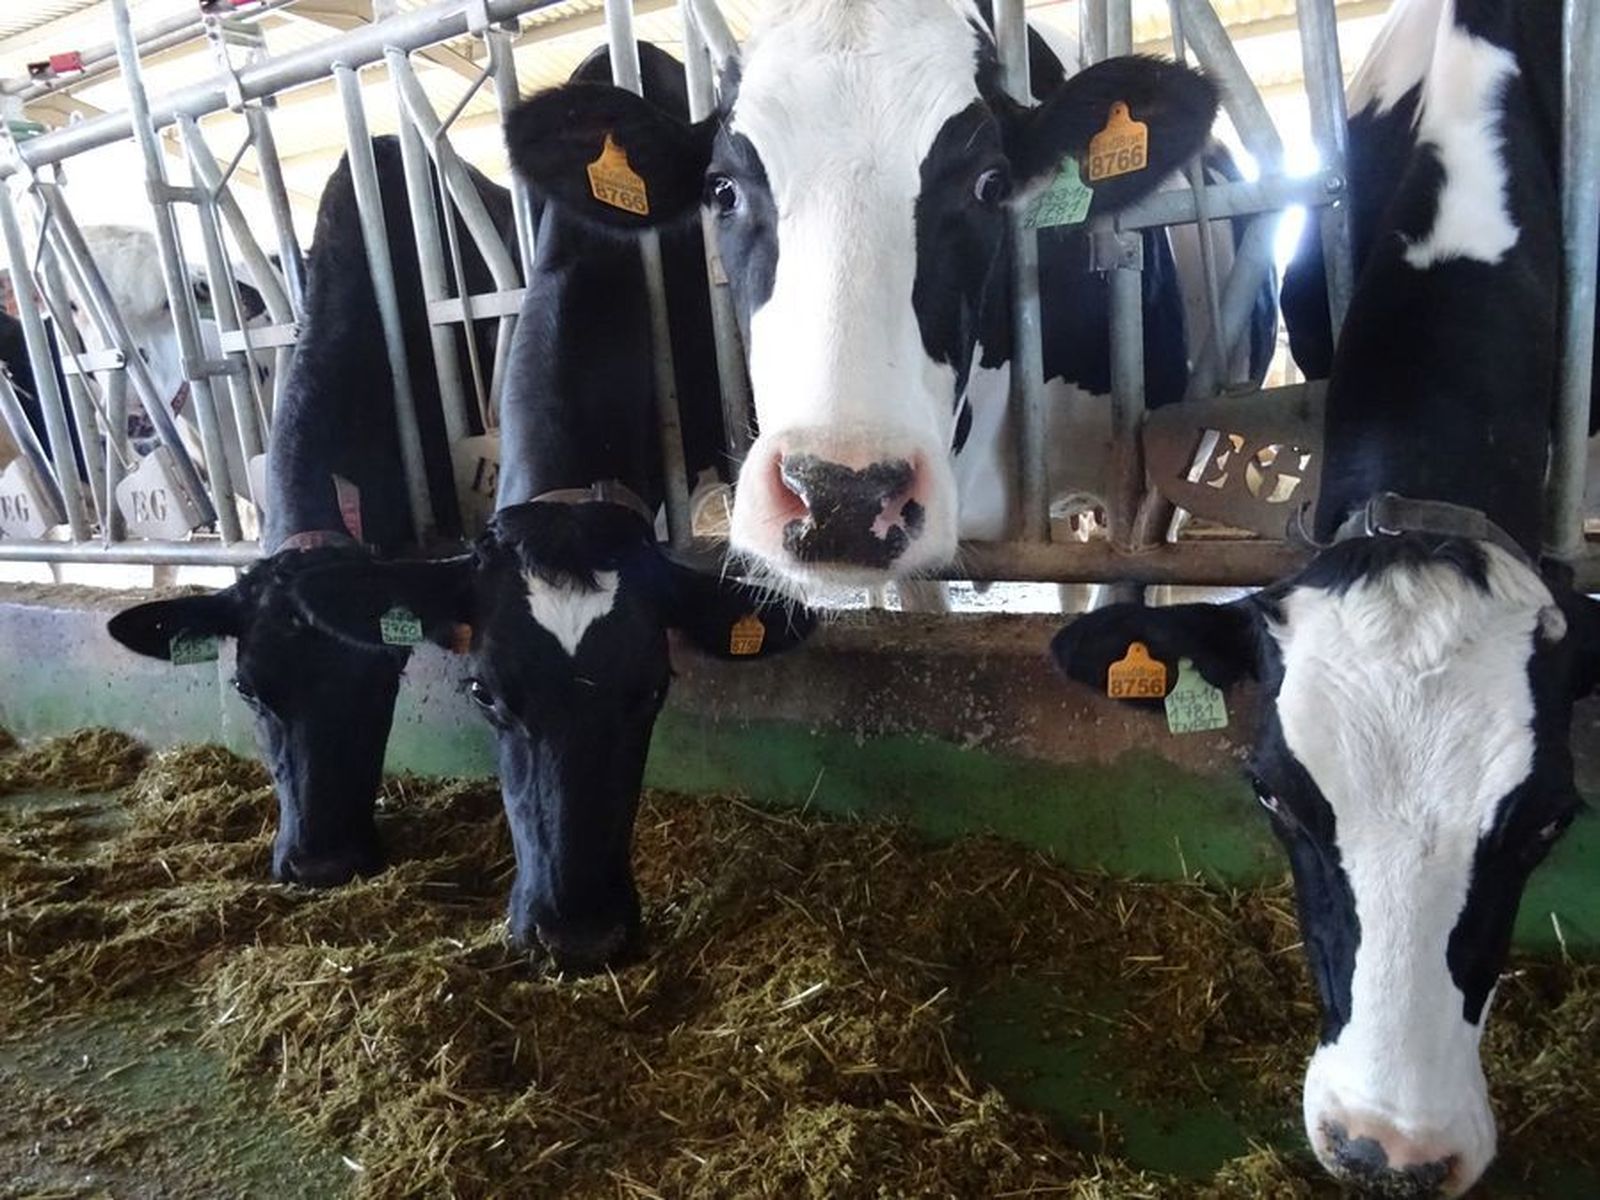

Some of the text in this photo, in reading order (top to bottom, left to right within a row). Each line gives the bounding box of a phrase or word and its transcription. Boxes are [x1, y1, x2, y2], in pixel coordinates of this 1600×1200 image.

[1091, 145, 1143, 178] 8766
[1186, 429, 1312, 503] EG
[1111, 679, 1163, 695] 8756
